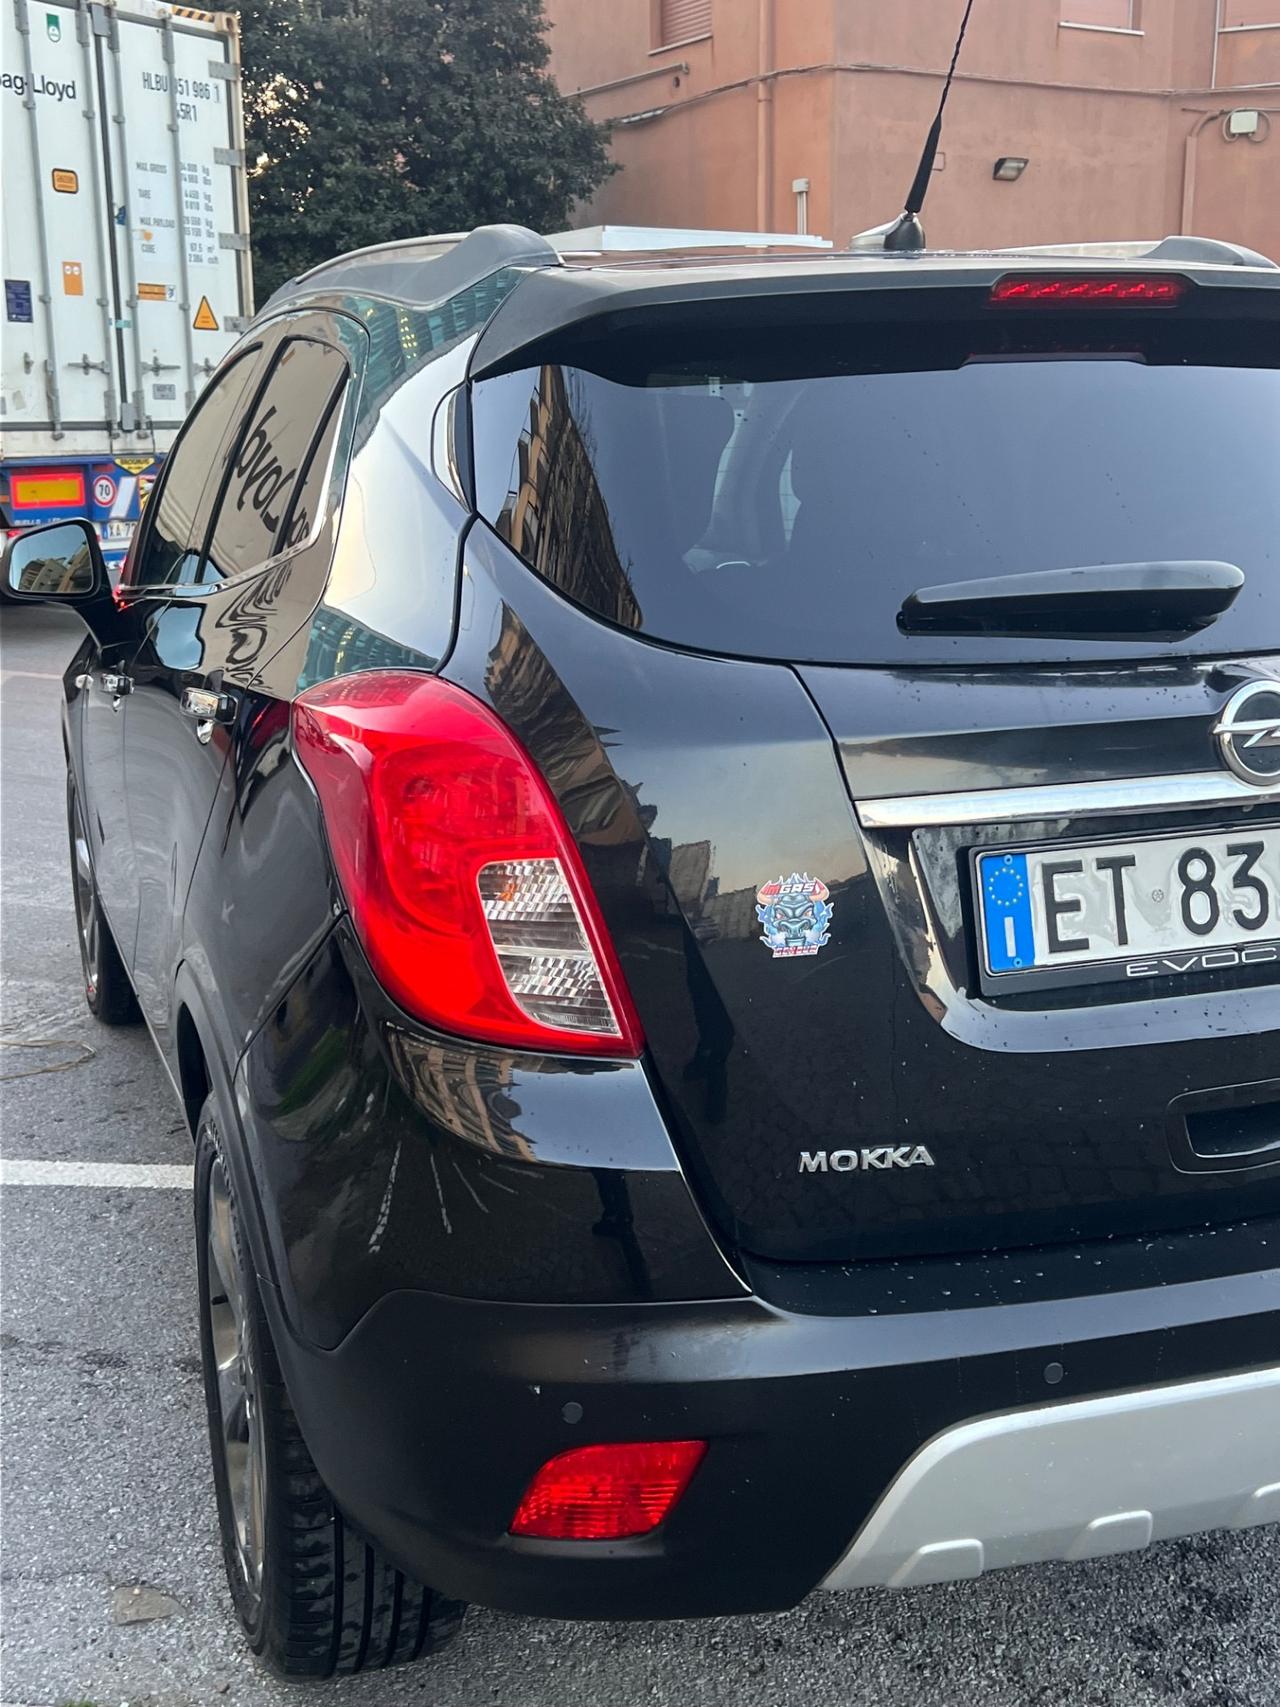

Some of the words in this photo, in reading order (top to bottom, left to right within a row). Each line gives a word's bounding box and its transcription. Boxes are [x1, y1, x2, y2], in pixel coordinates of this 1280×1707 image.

[0, 73, 76, 102] ag-Lloyd
[142, 71, 169, 92] HLBU
[193, 80, 211, 100] 986
[98, 484, 111, 496] 70
[779, 882, 816, 894] GAS
[1042, 854, 1136, 954] ET
[1177, 840, 1270, 936] 83
[1126, 947, 1278, 978] EVOC
[798, 1145, 935, 1173] MOKKA
